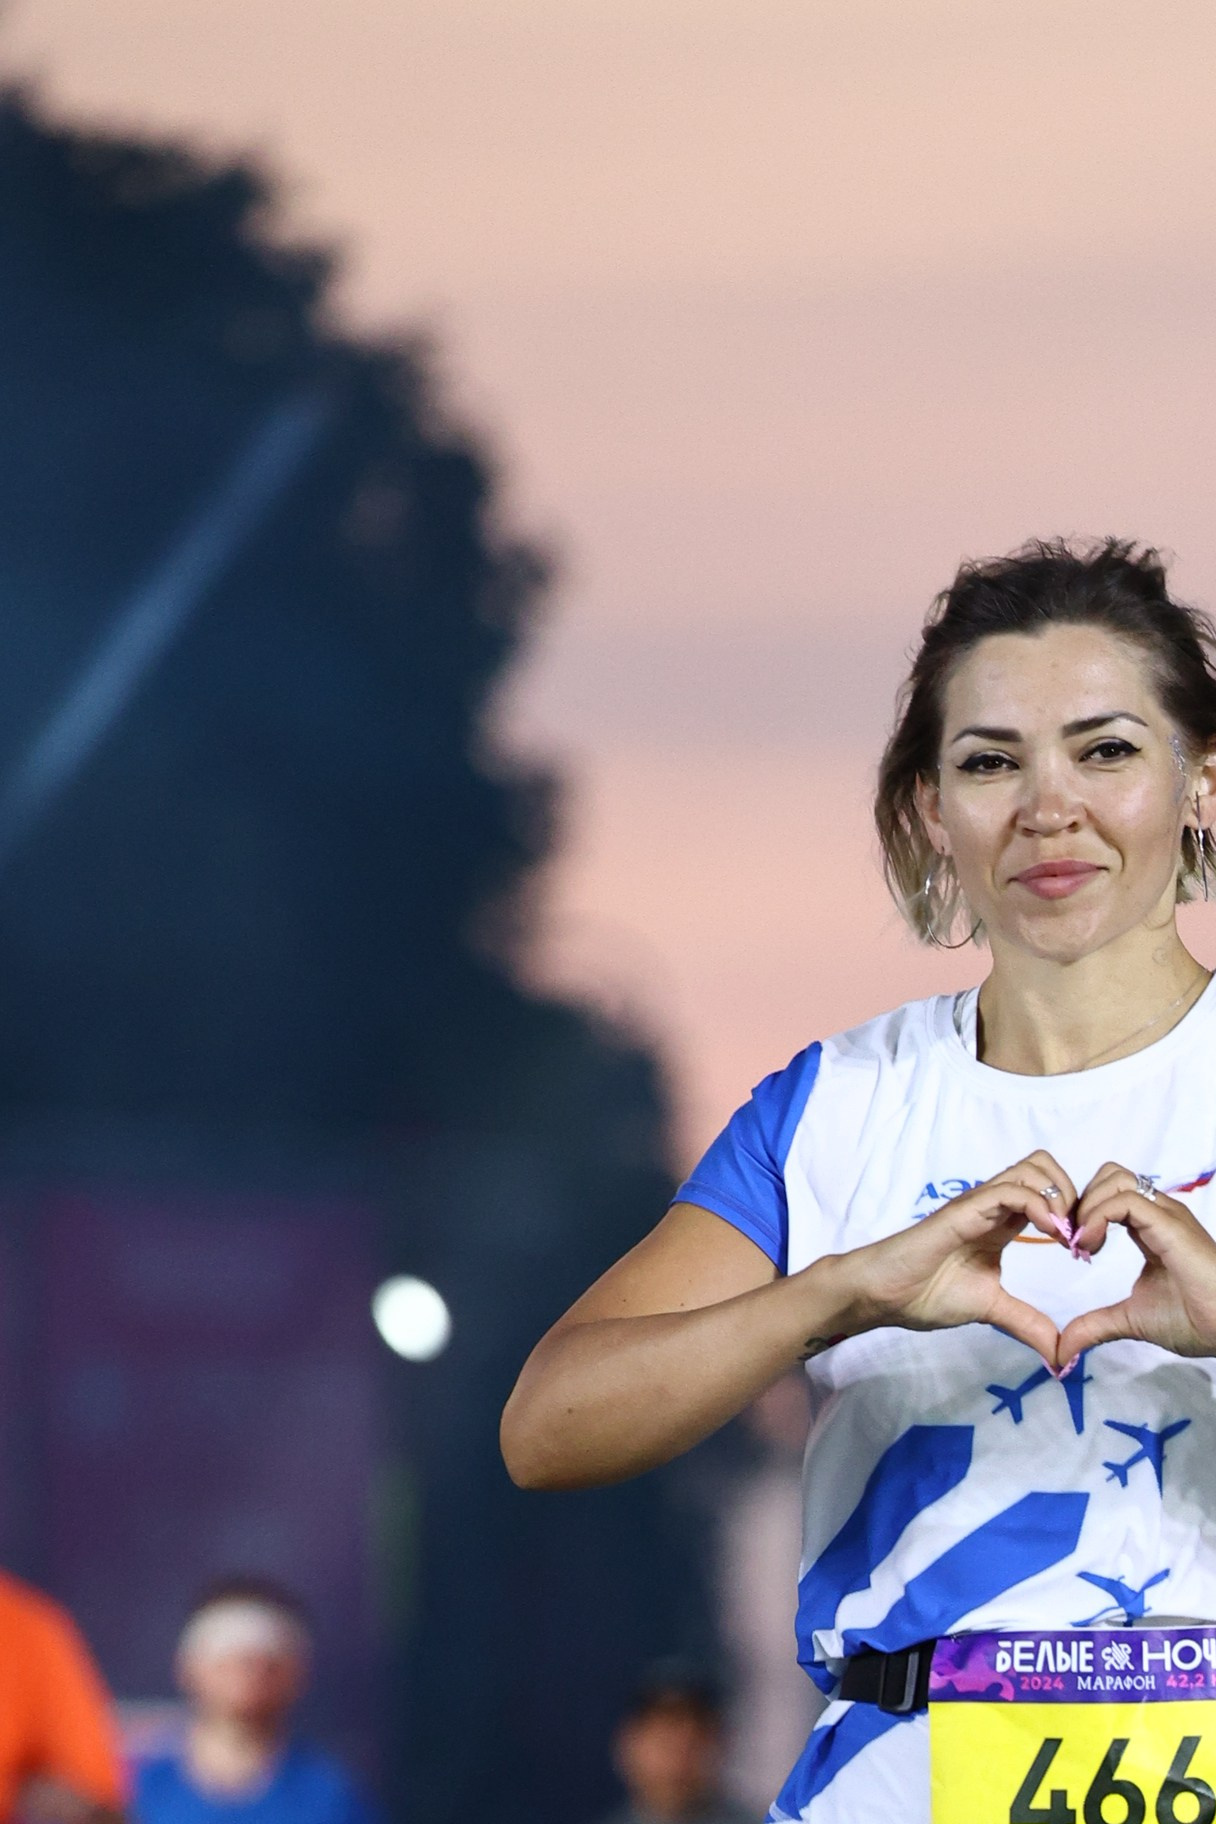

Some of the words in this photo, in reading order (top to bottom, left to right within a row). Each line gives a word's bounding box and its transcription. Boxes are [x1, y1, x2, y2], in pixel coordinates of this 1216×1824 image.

[996, 1640, 1094, 1673] БЕЛЫЕ
[1020, 1675, 1064, 1691] 2024
[1077, 1675, 1156, 1691] МАРАФОН
[1166, 1674, 1205, 1689] 42,2
